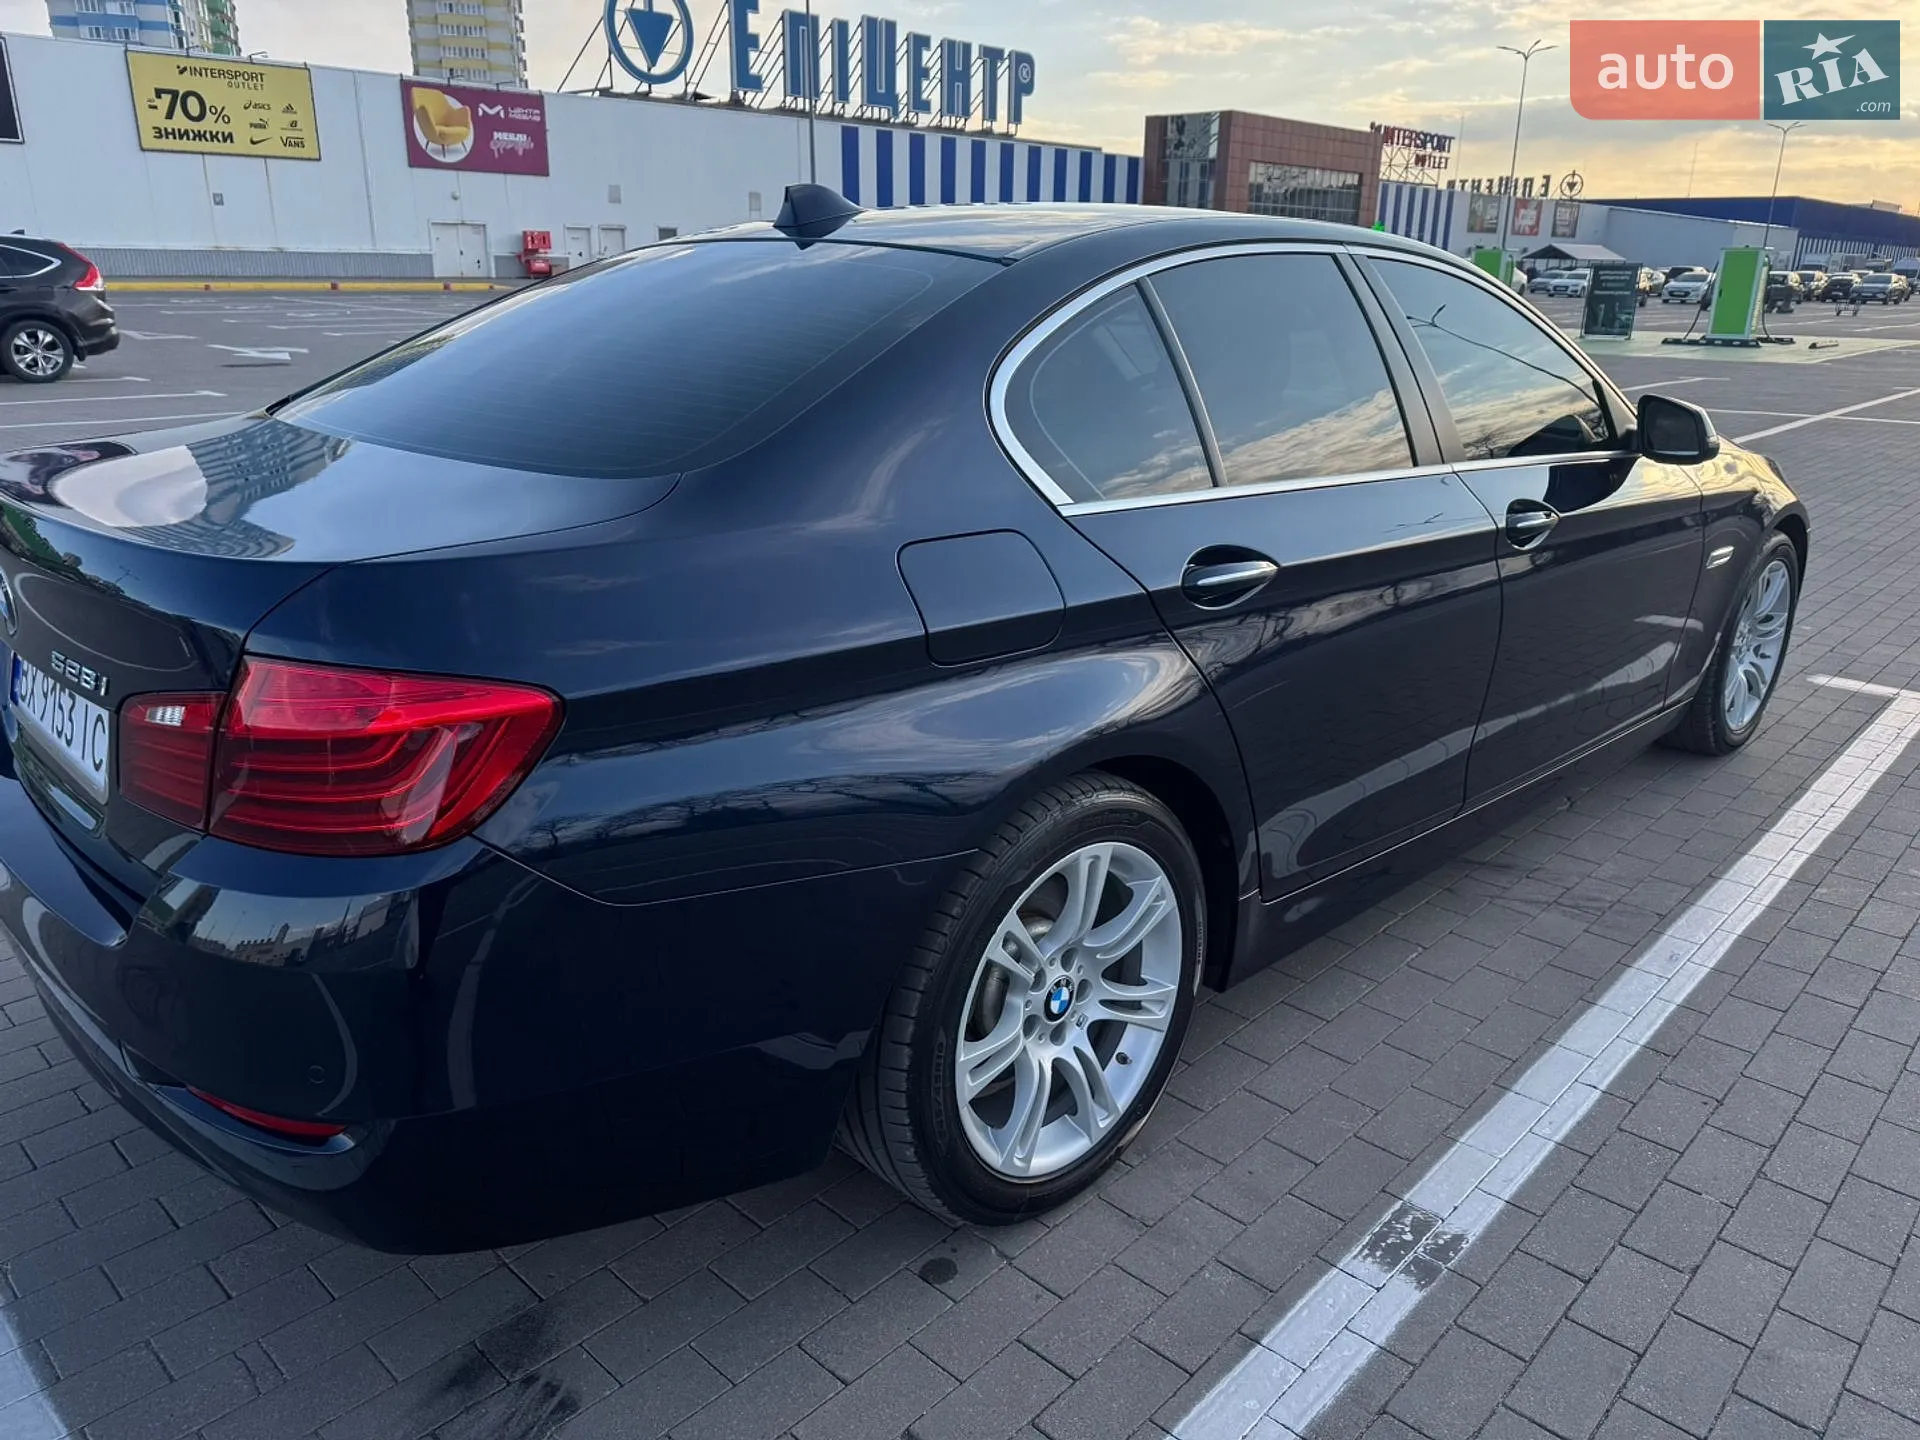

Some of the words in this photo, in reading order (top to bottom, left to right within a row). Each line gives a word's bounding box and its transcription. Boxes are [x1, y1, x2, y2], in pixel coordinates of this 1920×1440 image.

[189, 66, 265, 83] INTERSPORT
[227, 81, 265, 91] OUTLET
[152, 126, 235, 144] ЗНИЖКИ
[1383, 124, 1455, 153] INTERSPORT
[1414, 153, 1450, 170] OUTLET
[40, 675, 77, 748] 9153
